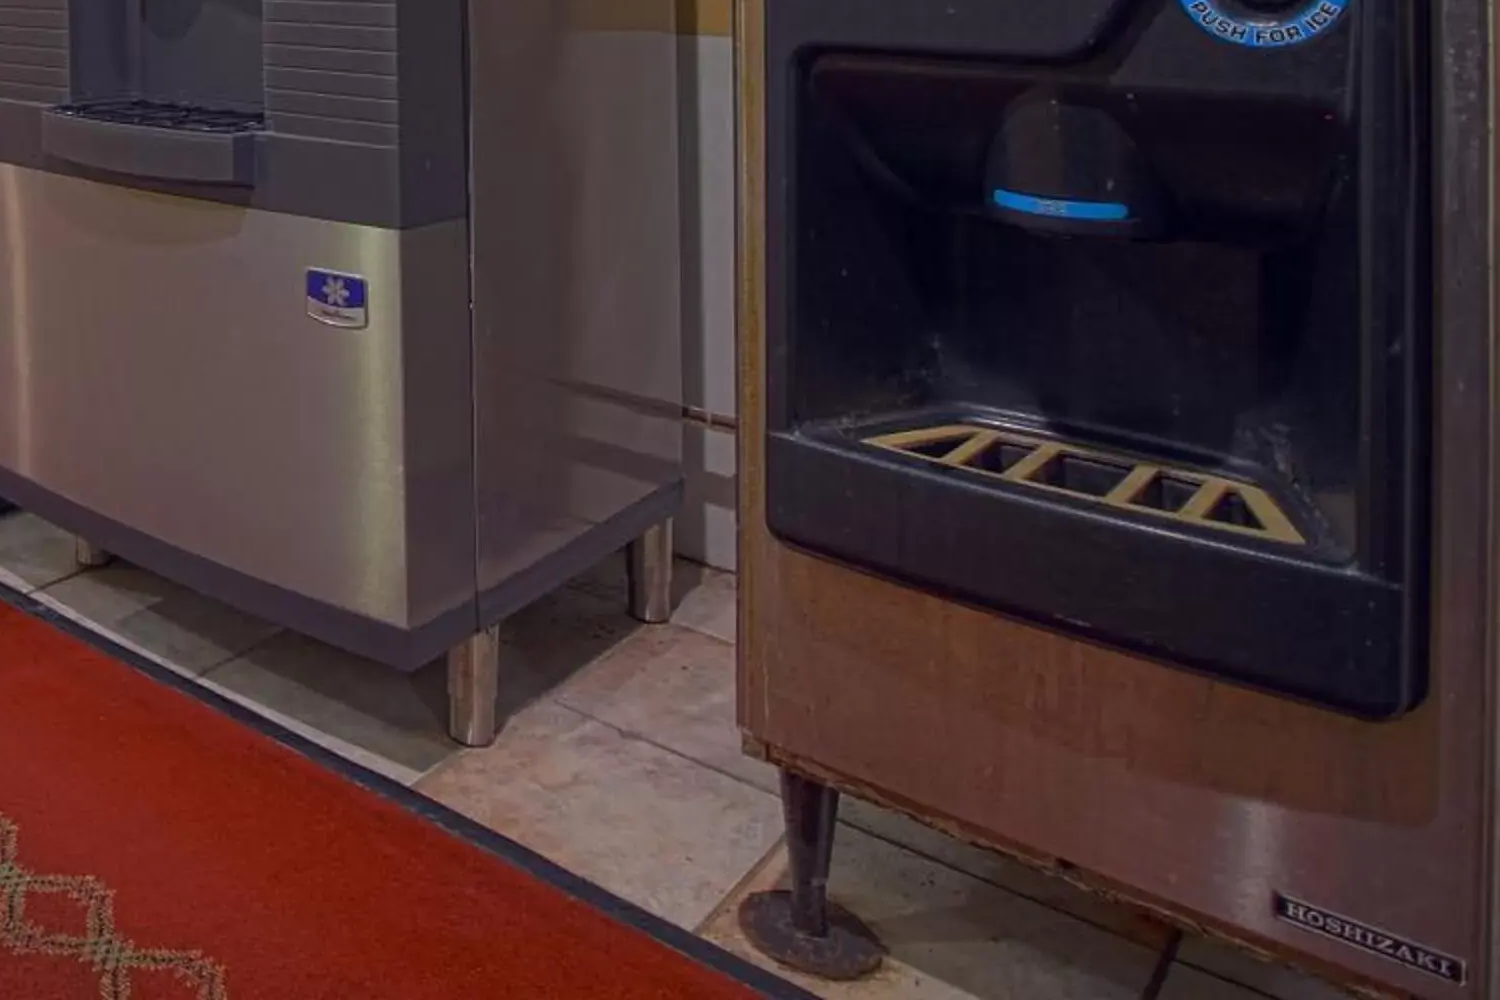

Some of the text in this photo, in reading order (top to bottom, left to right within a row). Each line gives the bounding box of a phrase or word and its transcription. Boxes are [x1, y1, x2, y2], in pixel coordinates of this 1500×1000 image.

[1189, 0, 1341, 45] PUSH FOR ICE
[1286, 900, 1453, 977] HOSHIZAKI
